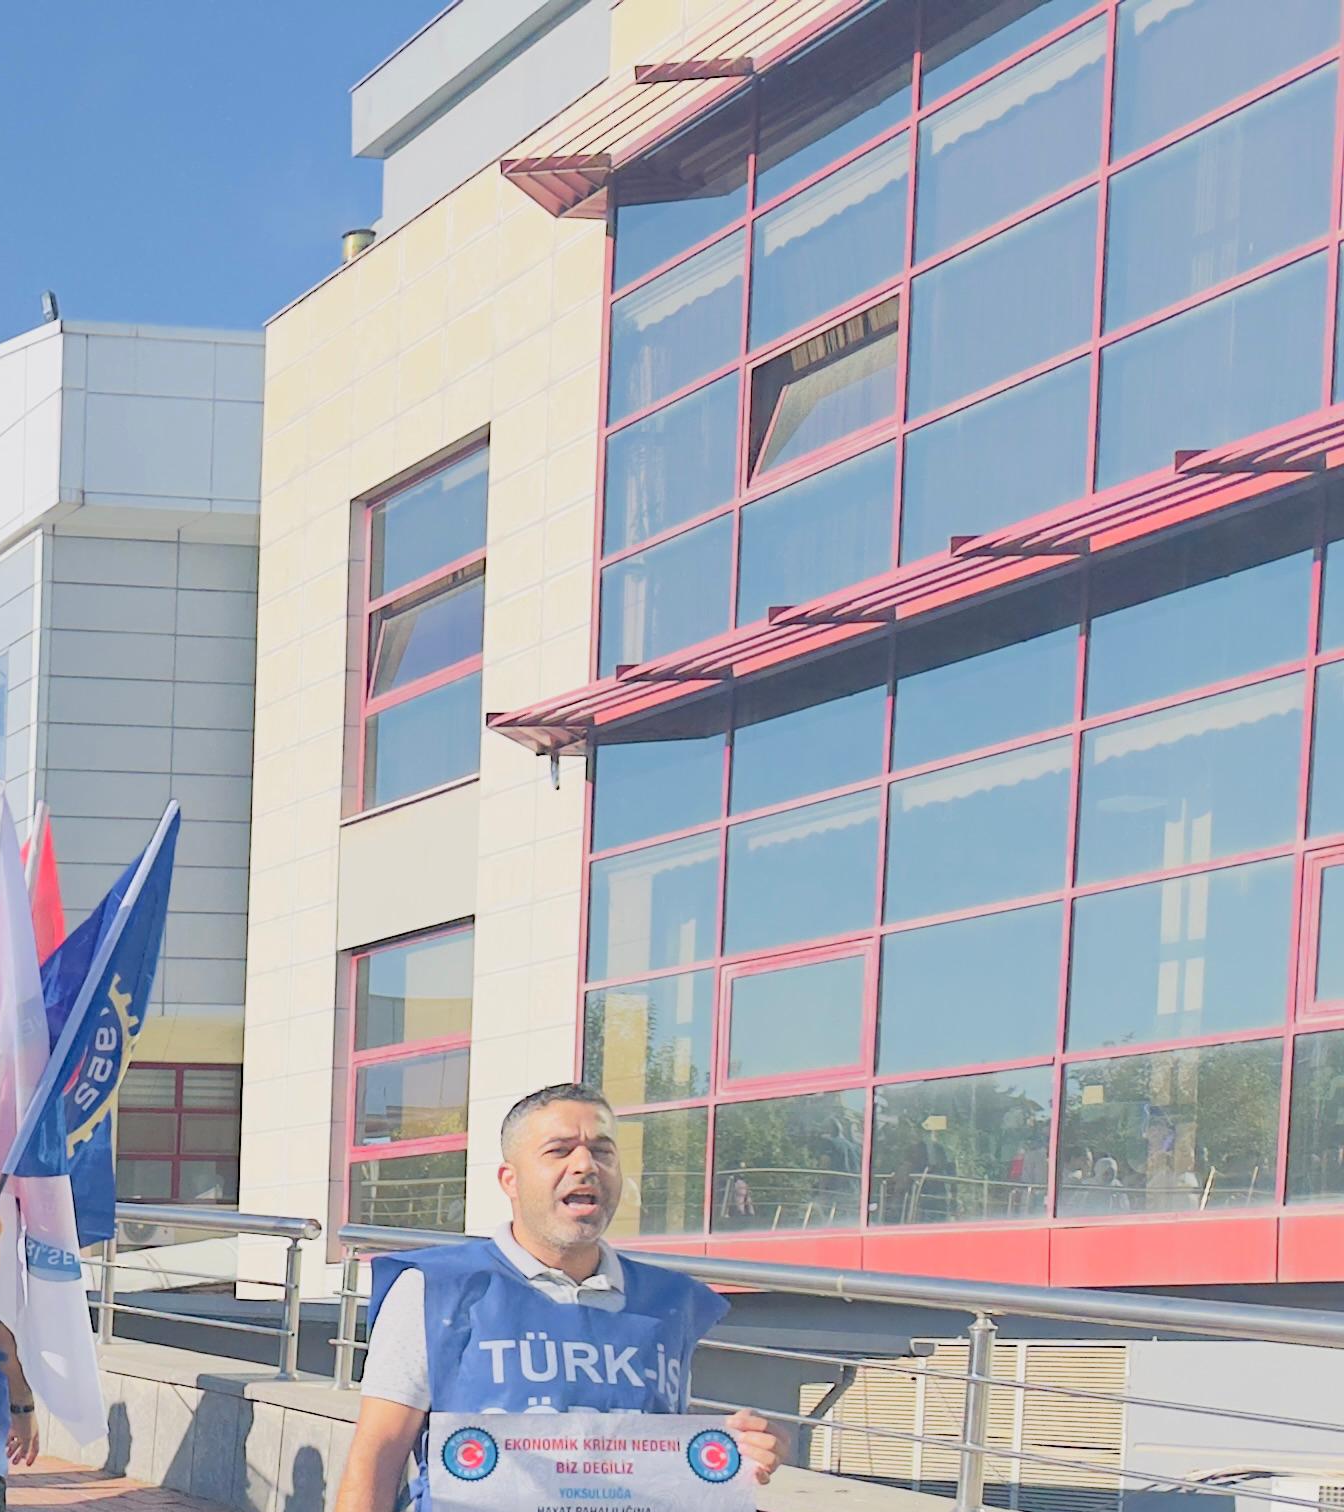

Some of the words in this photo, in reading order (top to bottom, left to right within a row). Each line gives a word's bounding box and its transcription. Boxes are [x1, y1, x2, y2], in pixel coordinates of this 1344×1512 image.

[505, 1435, 578, 1451] EKONOMİK
[583, 1435, 627, 1452] KRİZİN
[632, 1437, 681, 1452] NEDENİ
[556, 1461, 578, 1475] BİZ
